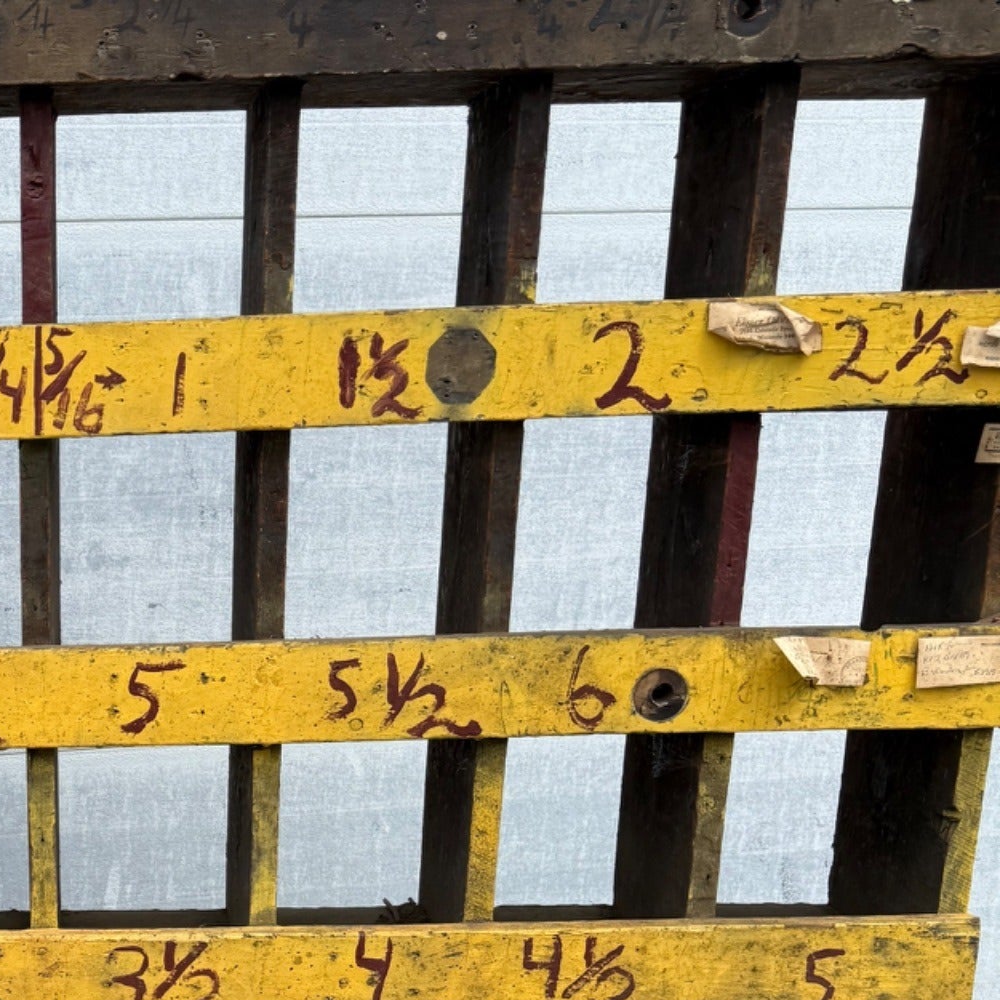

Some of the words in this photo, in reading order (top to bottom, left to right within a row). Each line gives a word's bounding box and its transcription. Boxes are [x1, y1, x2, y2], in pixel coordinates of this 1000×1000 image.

[173, 352, 186, 416] 1
[593, 321, 672, 410] 2
[121, 659, 187, 735] 5
[568, 644, 616, 731] 6
